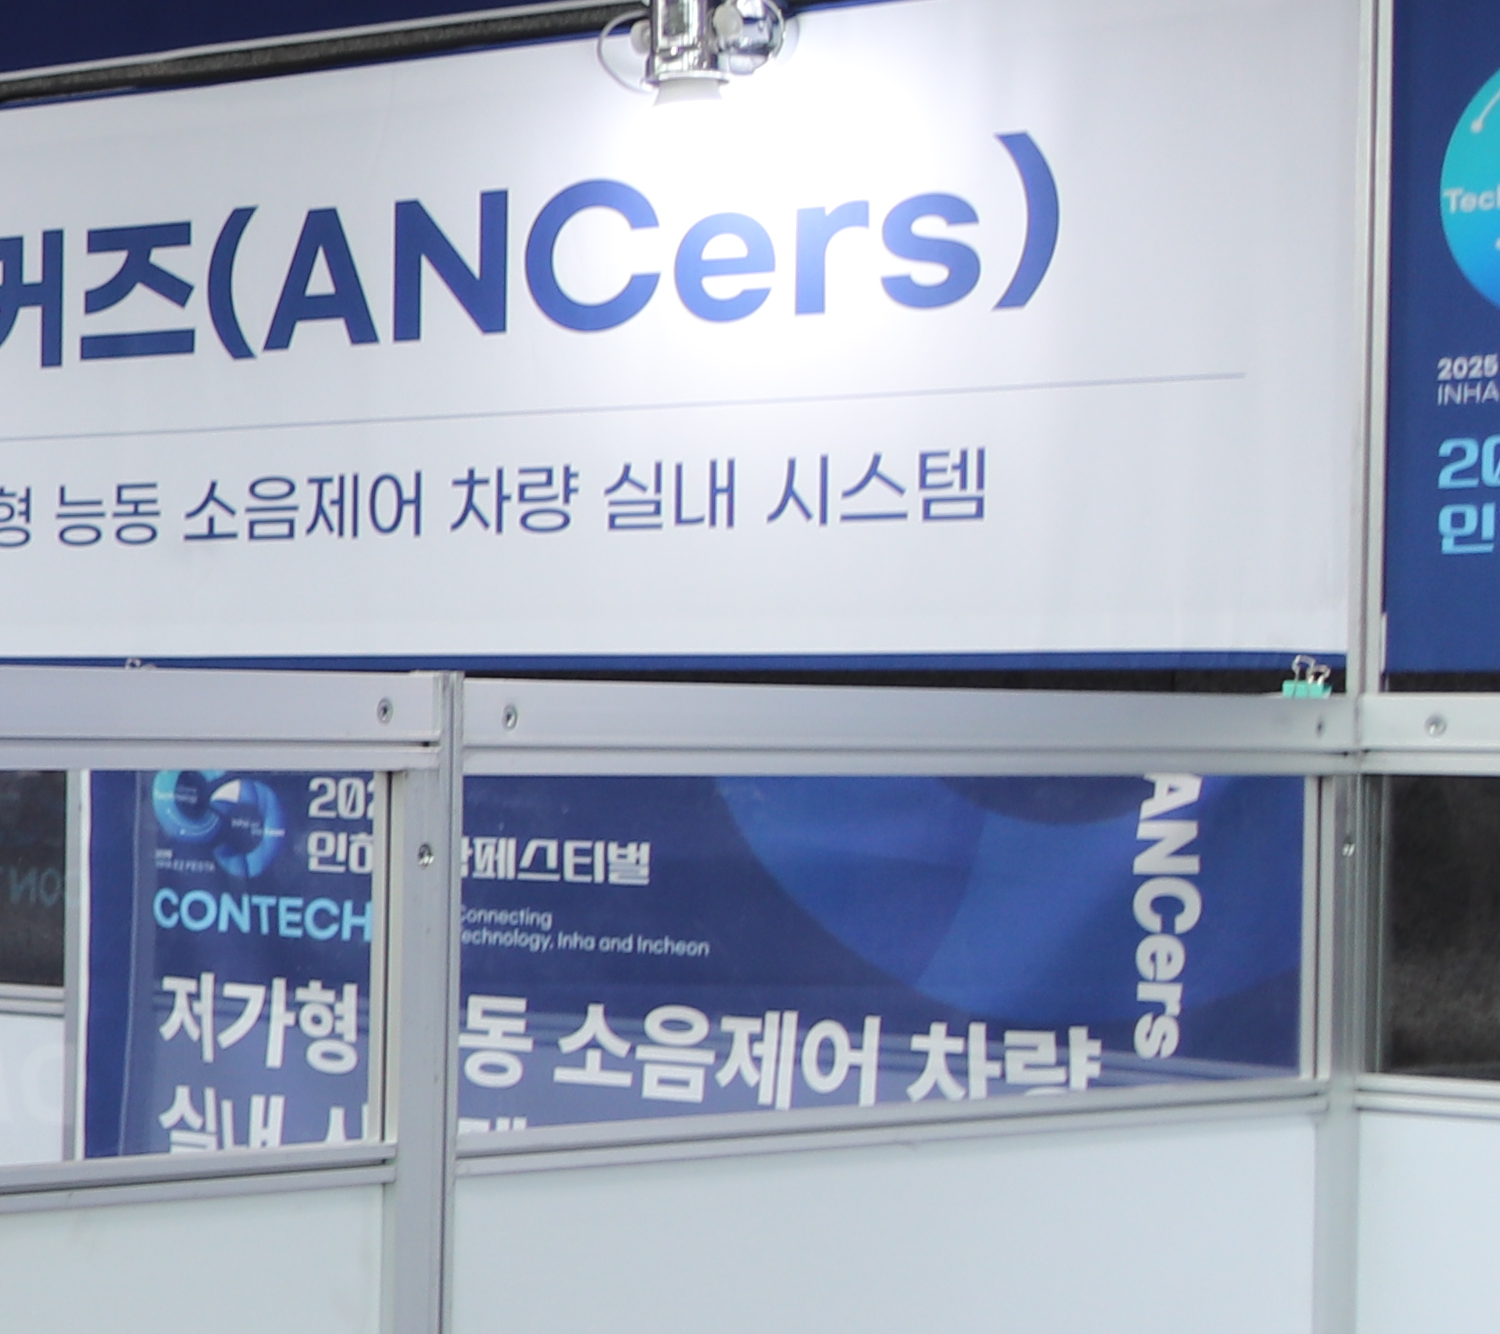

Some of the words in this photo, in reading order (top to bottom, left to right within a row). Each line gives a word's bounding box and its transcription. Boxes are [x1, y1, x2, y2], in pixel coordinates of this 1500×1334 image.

[1443, 183, 1500, 215] Tec
[1437, 353, 1498, 381] 2025
[53, 483, 162, 547] 능동
[181, 468, 425, 544] 소음제어
[449, 462, 581, 536] 차량
[601, 458, 737, 534] 실내
[765, 445, 990, 527] 시스템
[557, 930, 595, 950] Inha
[599, 932, 634, 953] and
[637, 934, 711, 958] Incheon
[1132, 771, 1204, 1061] ANCers
[158, 971, 359, 1076] 저가형
[552, 1002, 883, 1111] 소음제어
[905, 1020, 1103, 1103] 차량
